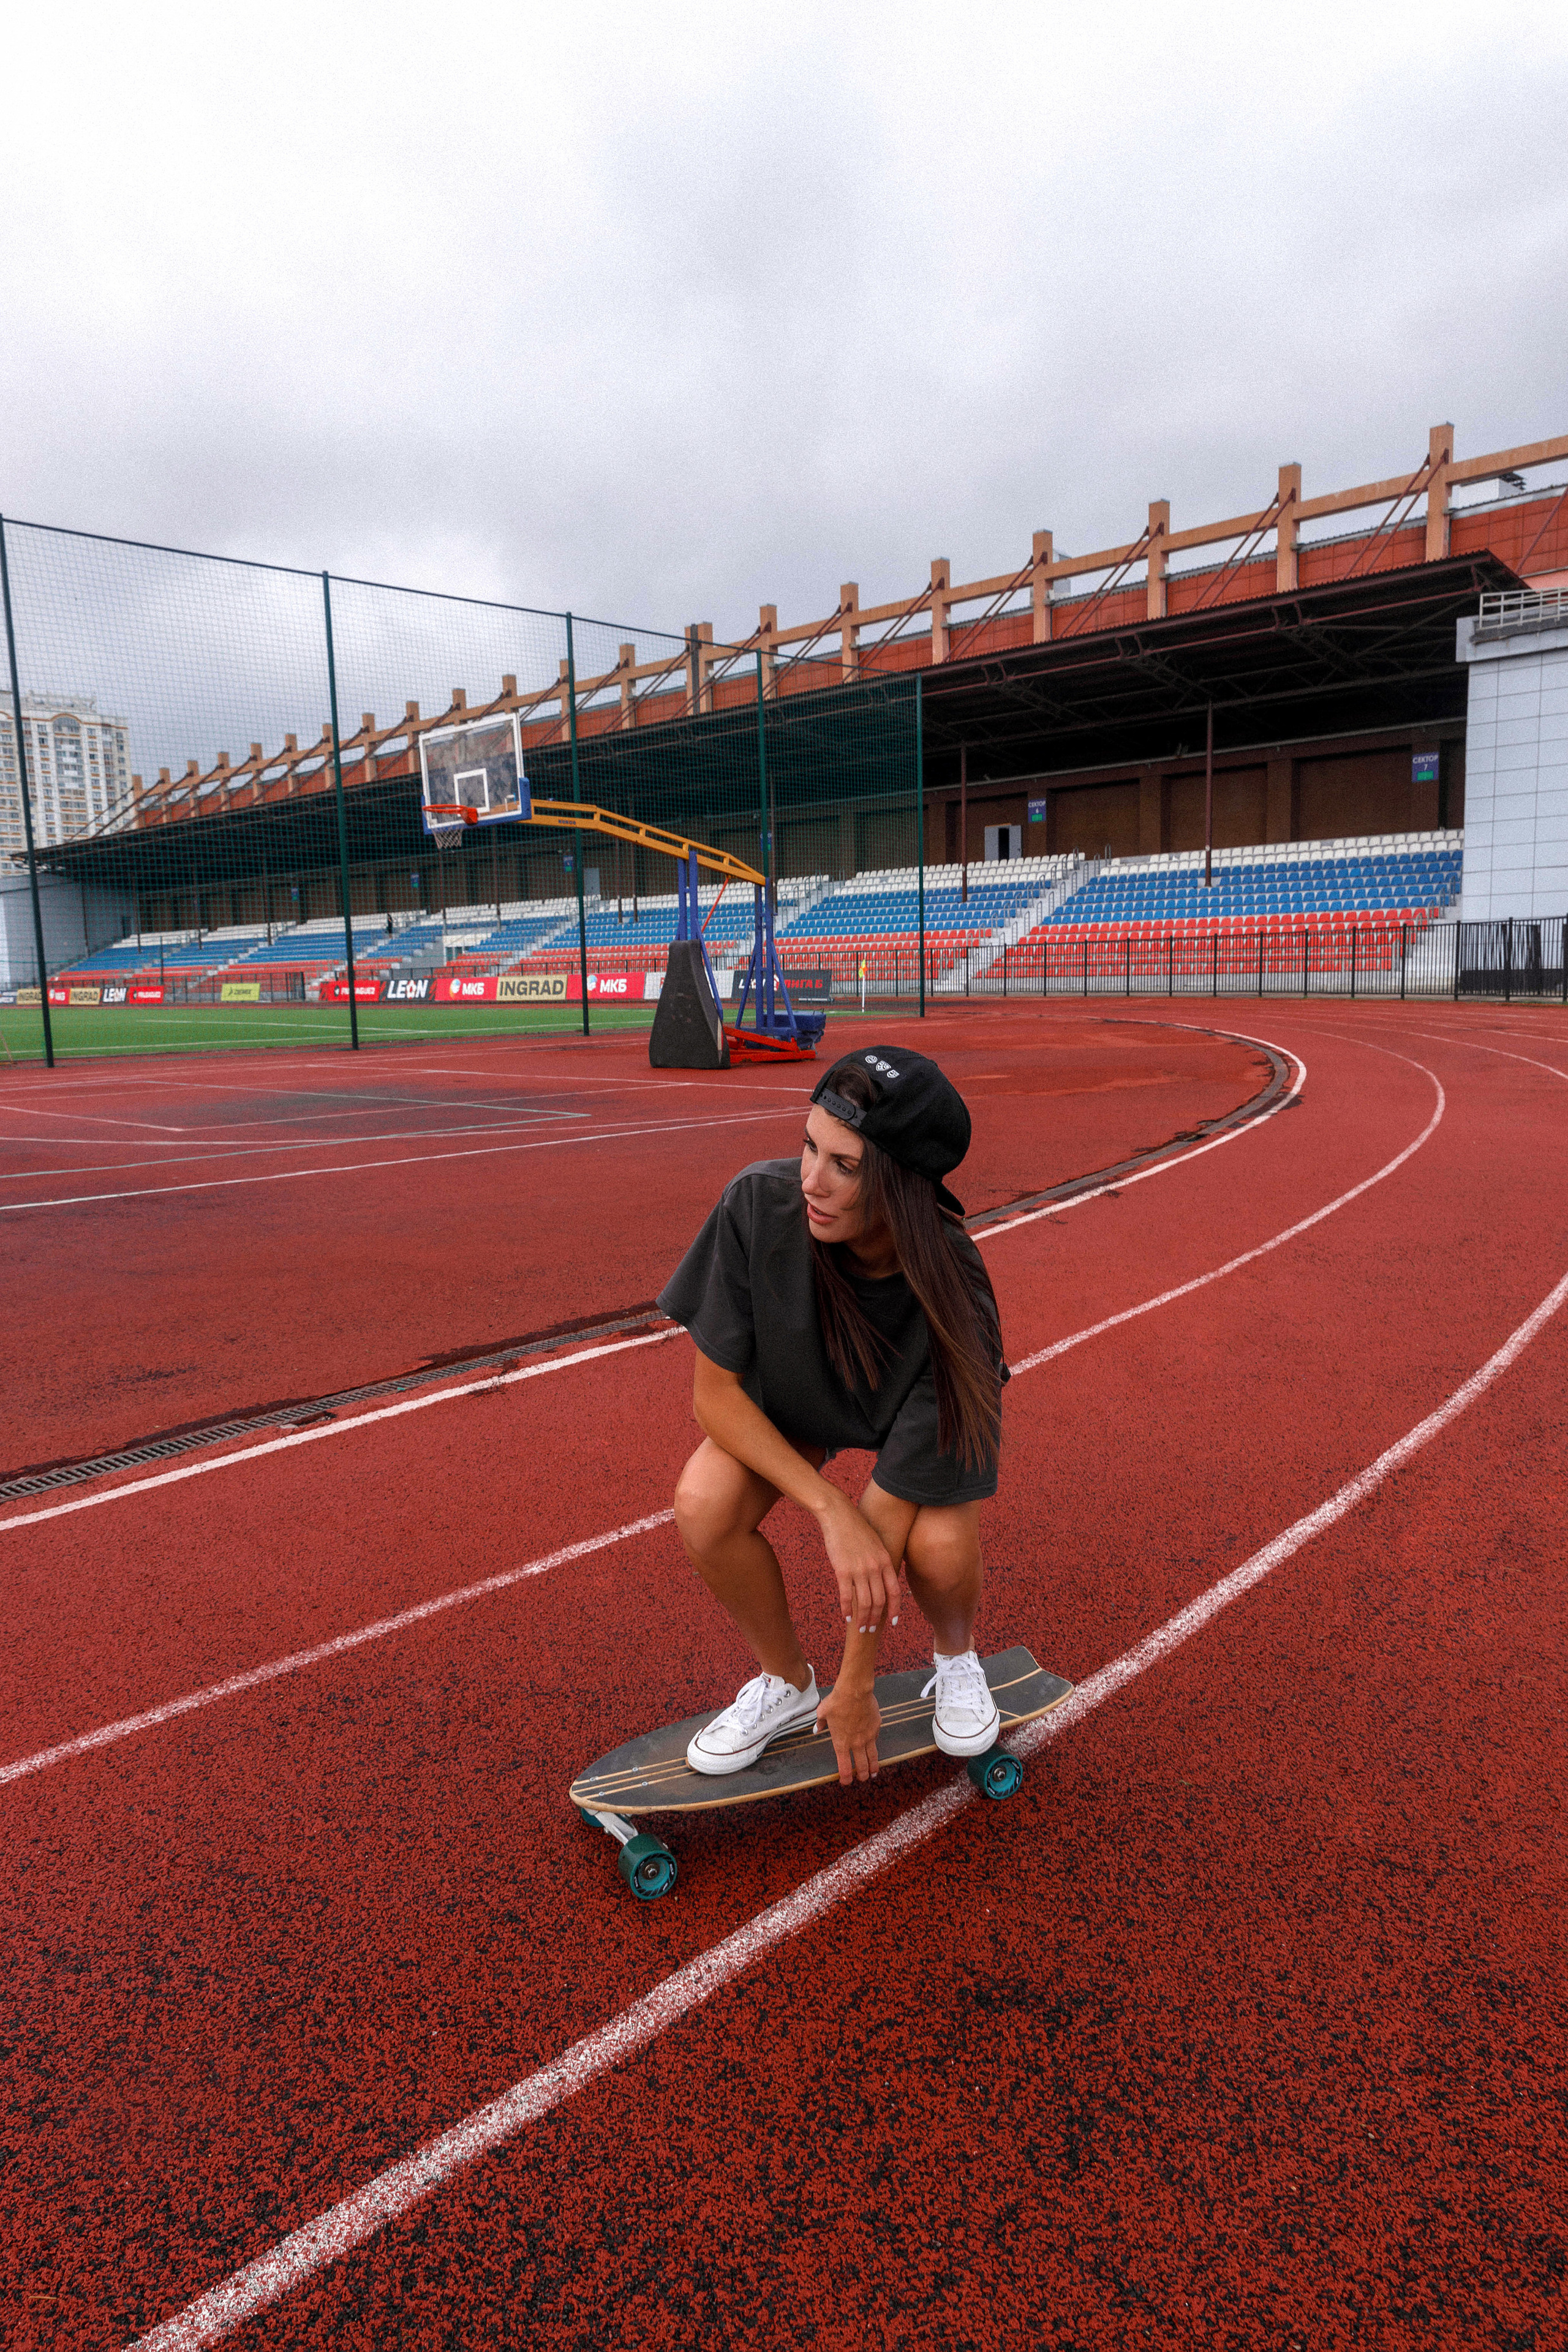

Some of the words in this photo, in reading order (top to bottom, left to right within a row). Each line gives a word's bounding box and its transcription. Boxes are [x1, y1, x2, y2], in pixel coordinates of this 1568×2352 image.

[1412, 755, 1438, 764] СЕКТОР
[387, 980, 429, 999] LEON
[462, 982, 484, 995] МКБ
[499, 980, 564, 996] INGRAD
[600, 979, 627, 993] МКБ
[815, 979, 823, 989] Б
[71, 990, 98, 1001] INGRAD
[103, 988, 127, 1002] LEON
